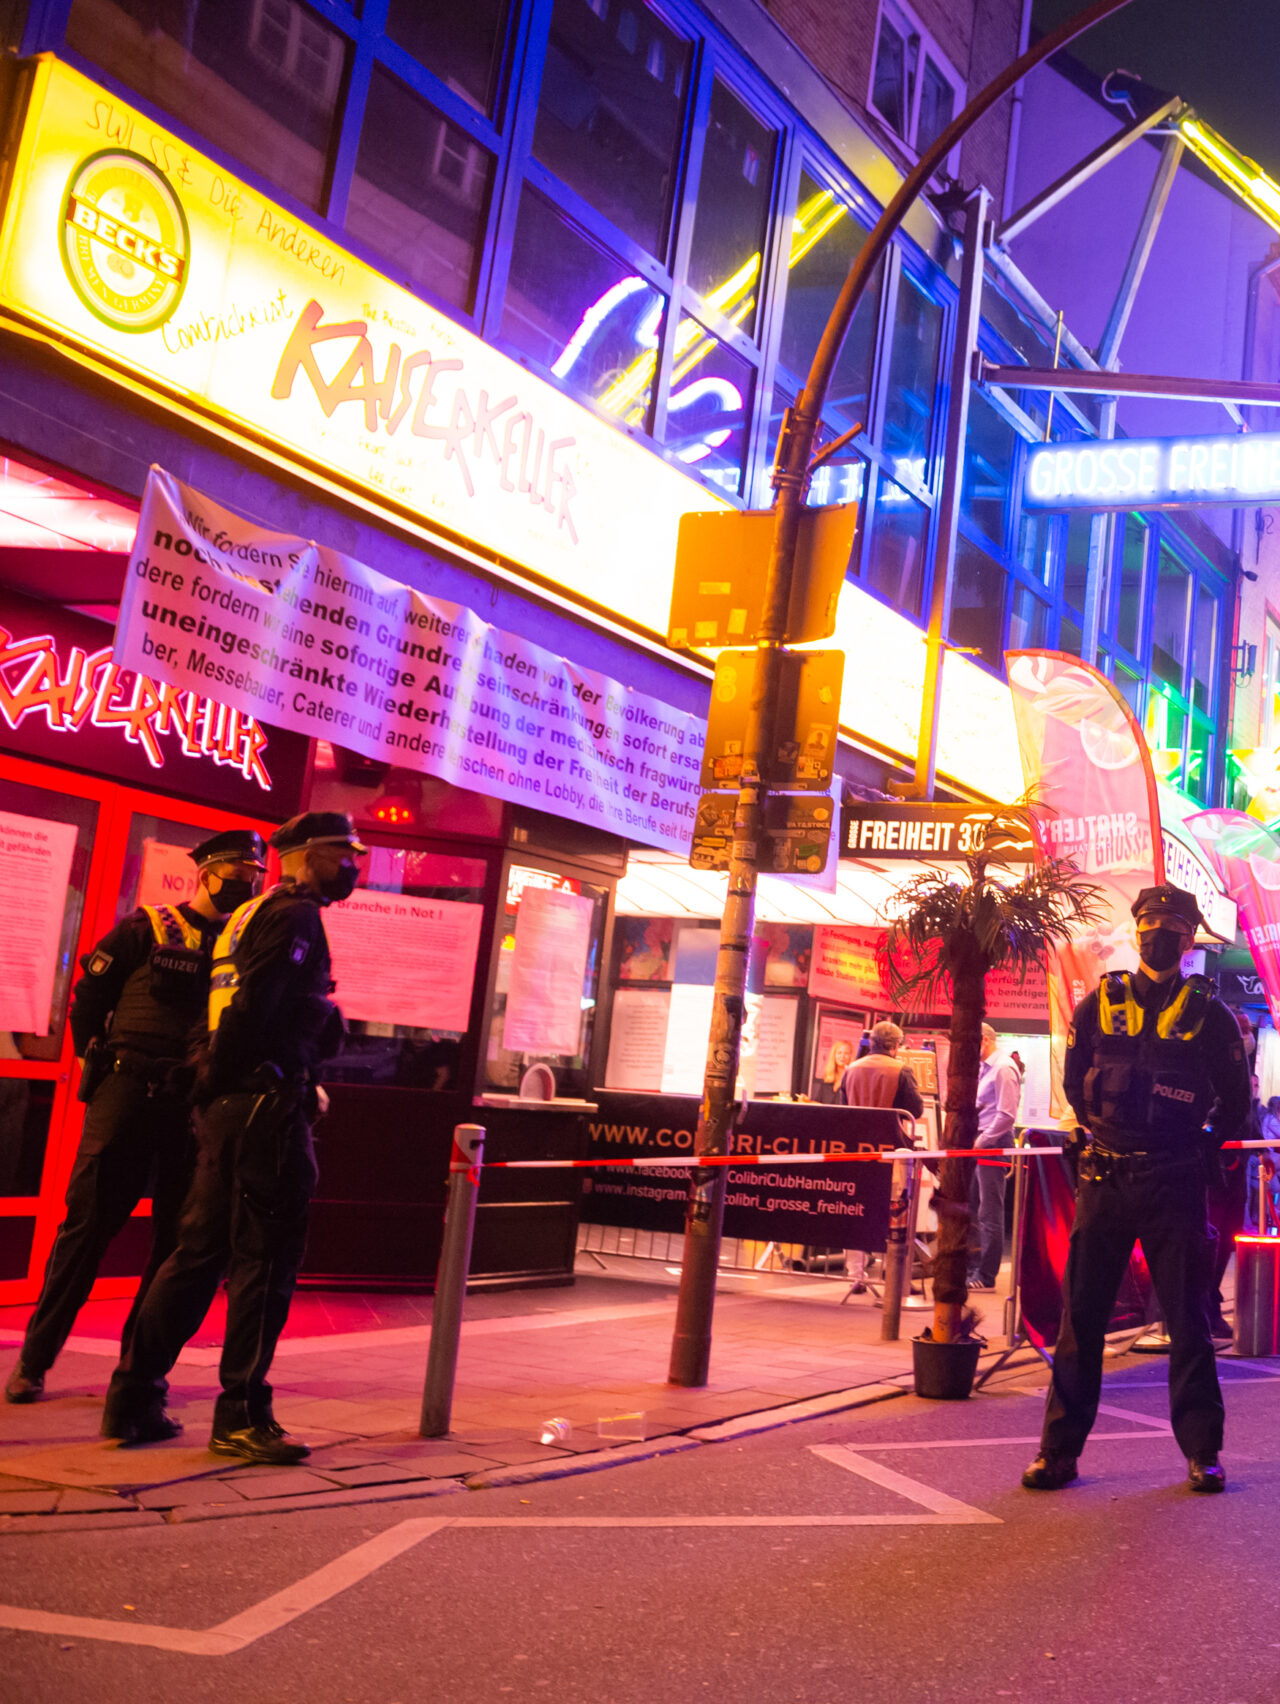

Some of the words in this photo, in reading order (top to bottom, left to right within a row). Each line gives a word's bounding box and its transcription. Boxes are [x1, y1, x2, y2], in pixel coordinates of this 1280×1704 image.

[73, 200, 178, 277] BECK'S
[256, 207, 345, 287] Anderen
[271, 299, 579, 550] KAISERKELLER
[1031, 446, 1159, 497] GROSSE
[212, 530, 283, 568] fordern
[314, 565, 374, 607] hiermit
[376, 593, 398, 622] auf,
[542, 668, 569, 691] von
[572, 682, 602, 706] der
[605, 694, 685, 744] Bevölkerung
[136, 557, 184, 592] dere
[191, 576, 259, 624] fordern
[281, 621, 315, 650] eine
[321, 637, 416, 688] sofortige
[515, 716, 545, 740] der
[550, 728, 635, 775] medizinisch
[639, 760, 705, 797] fragwürd
[141, 599, 359, 697] uneingeschränkte
[364, 681, 529, 765] Wiederherstellung
[533, 749, 565, 773] der
[569, 760, 619, 796] Freiheit
[623, 784, 648, 805] der
[650, 792, 696, 819] Berufs
[141, 632, 179, 670] ber,
[186, 648, 285, 712] Messebauer,
[293, 691, 357, 729] Caterer
[358, 716, 382, 741] und
[385, 728, 445, 760] andere
[508, 770, 542, 794] ohne
[546, 779, 586, 811] Lobby,
[589, 793, 605, 813] die
[626, 807, 658, 833] Berufe
[659, 821, 677, 840] seit
[680, 827, 695, 844] lan
[623, 732, 667, 760] sofort
[669, 751, 703, 773] ersa
[847, 819, 859, 848] GROSSE
[859, 819, 955, 851] FREIHEIT
[162, 873, 185, 891] NO
[337, 898, 391, 917] Branche
[395, 905, 407, 917] in
[410, 906, 436, 921] Not
[153, 955, 199, 974] POLIZEI
[1152, 1083, 1196, 1104] POLIZEI
